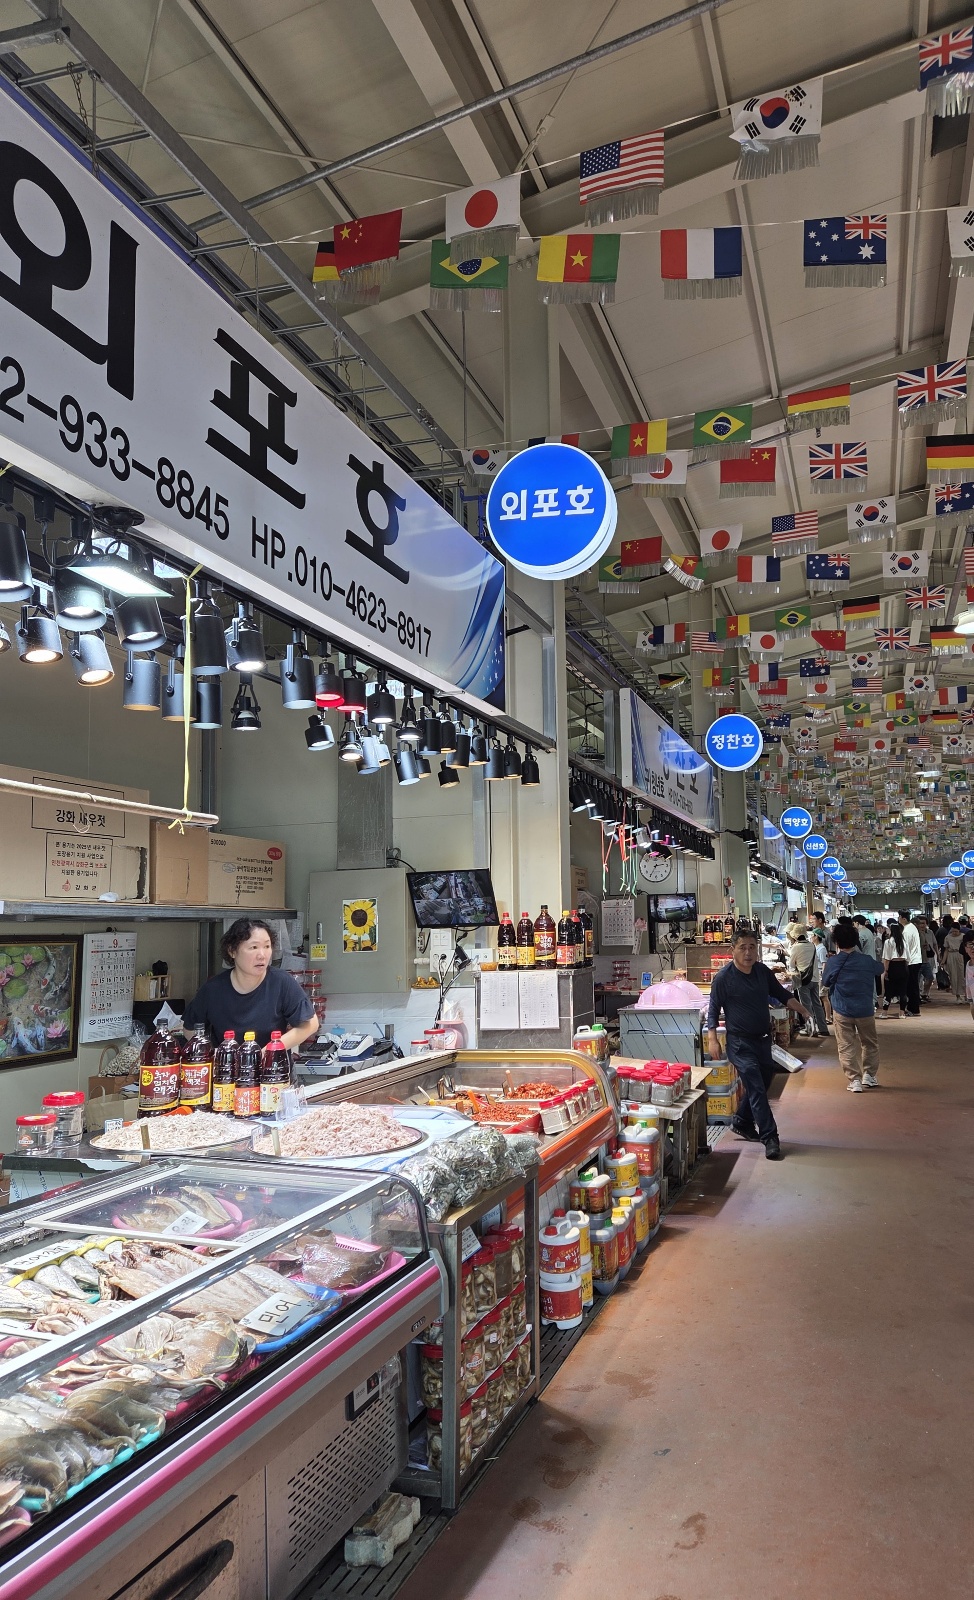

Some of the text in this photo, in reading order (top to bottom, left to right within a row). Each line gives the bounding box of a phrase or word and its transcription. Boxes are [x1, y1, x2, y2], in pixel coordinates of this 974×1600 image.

[499, 484, 595, 521] 외포호
[711, 733, 755, 750] 정찬호
[56, 809, 106, 828] 강화 새우젓
[784, 818, 809, 827] 백양호
[113, 938, 118, 948] 9
[258, 1299, 302, 1325] 민어
